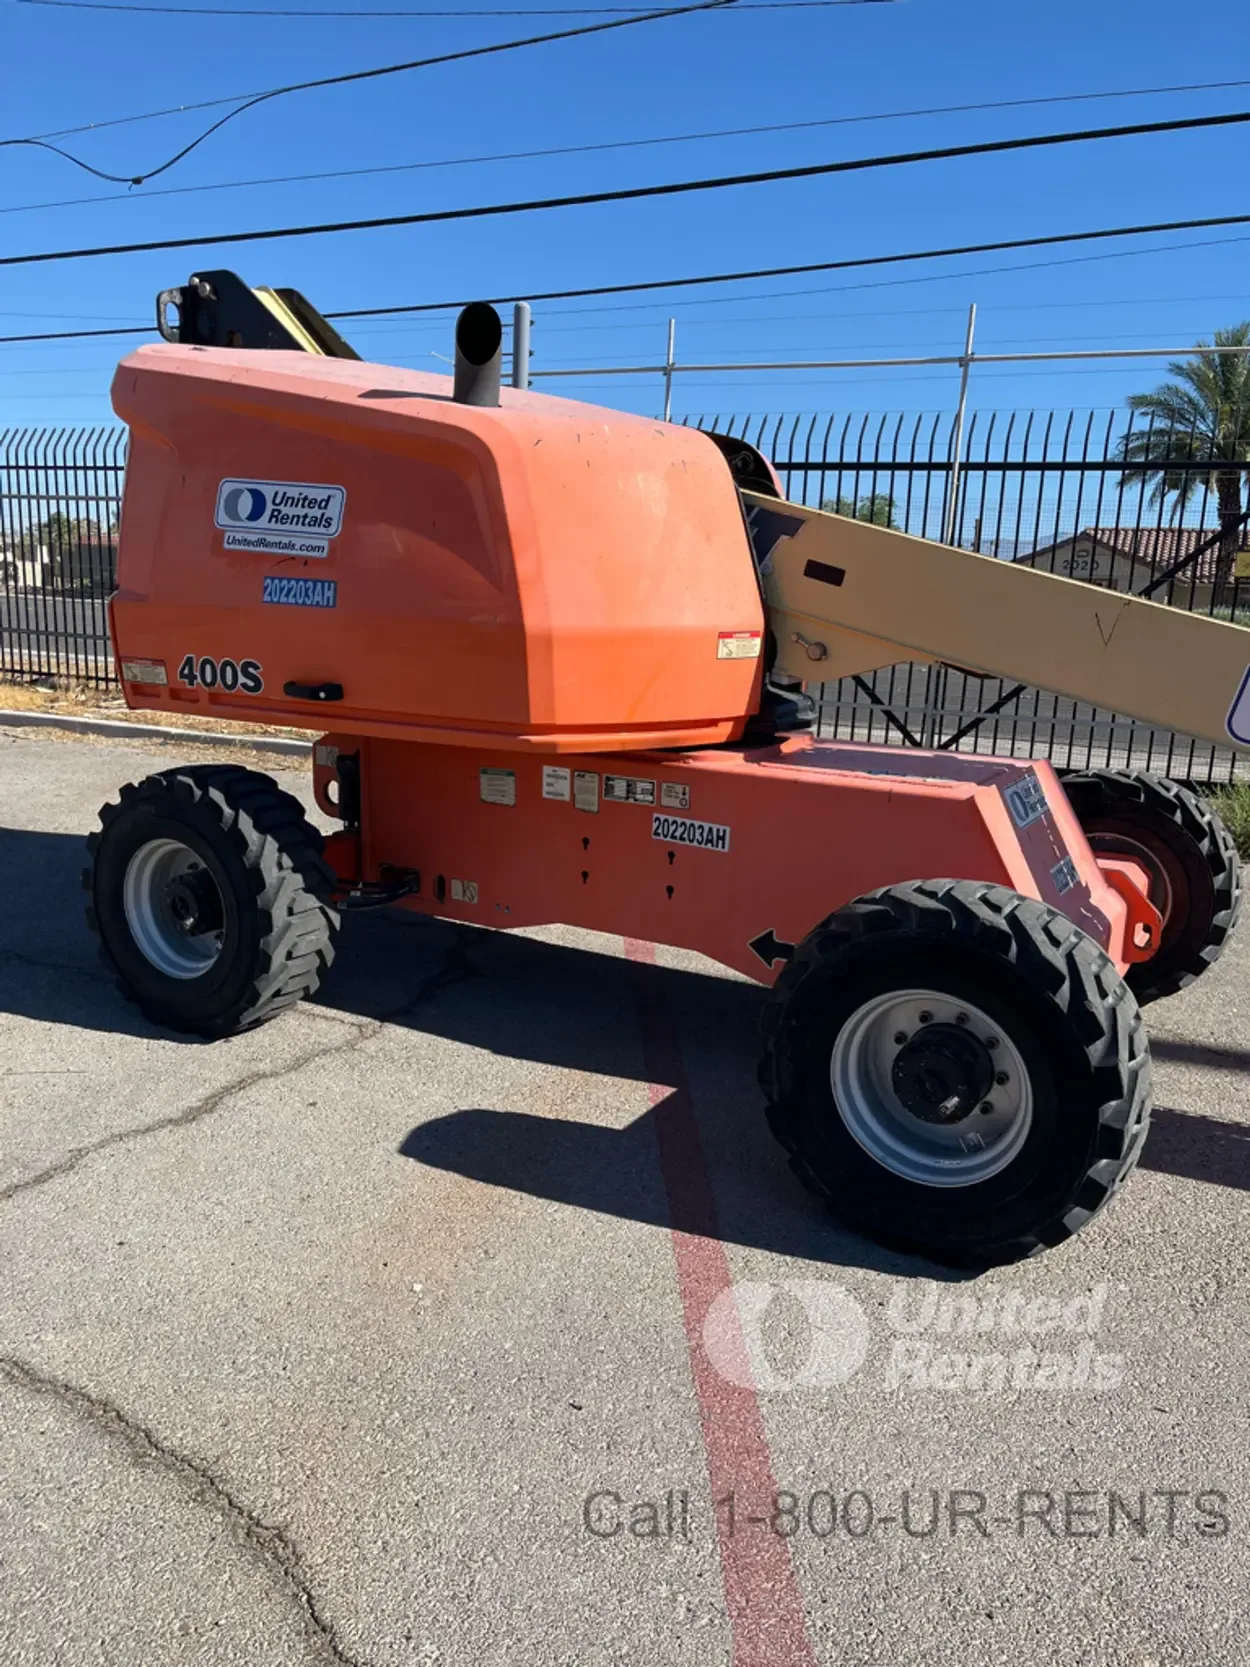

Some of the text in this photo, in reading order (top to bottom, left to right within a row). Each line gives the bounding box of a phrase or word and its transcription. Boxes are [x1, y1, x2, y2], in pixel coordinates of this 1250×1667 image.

[271, 490, 332, 511] United
[268, 508, 333, 529] Rentals
[226, 535, 325, 554] UnitedRentals.com
[263, 578, 336, 606] 202203AH
[178, 654, 263, 694] 400S
[652, 815, 727, 850] 202203AH
